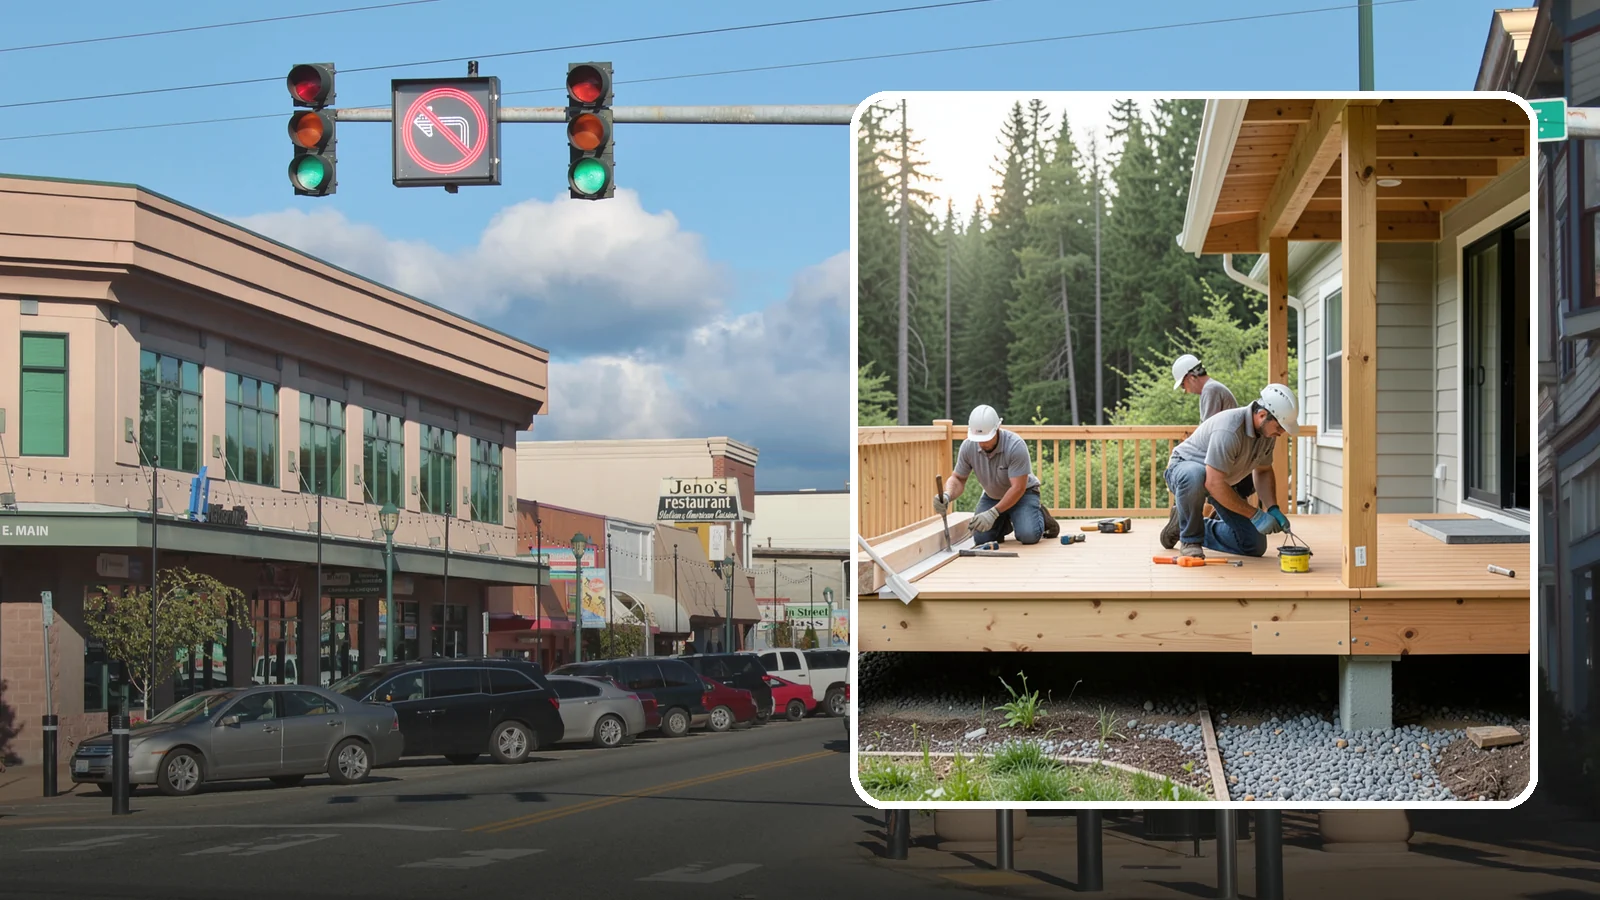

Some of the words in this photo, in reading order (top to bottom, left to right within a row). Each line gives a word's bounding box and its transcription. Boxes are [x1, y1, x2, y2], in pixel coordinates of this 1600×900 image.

[670, 480, 728, 494] Jeno's
[665, 496, 731, 509] restaurant
[658, 510, 681, 519] Italian
[686, 510, 714, 519] American
[715, 509, 737, 519] Cuisine
[2, 525, 13, 536] E.
[15, 525, 49, 536] MAIN
[797, 608, 828, 617] Street
